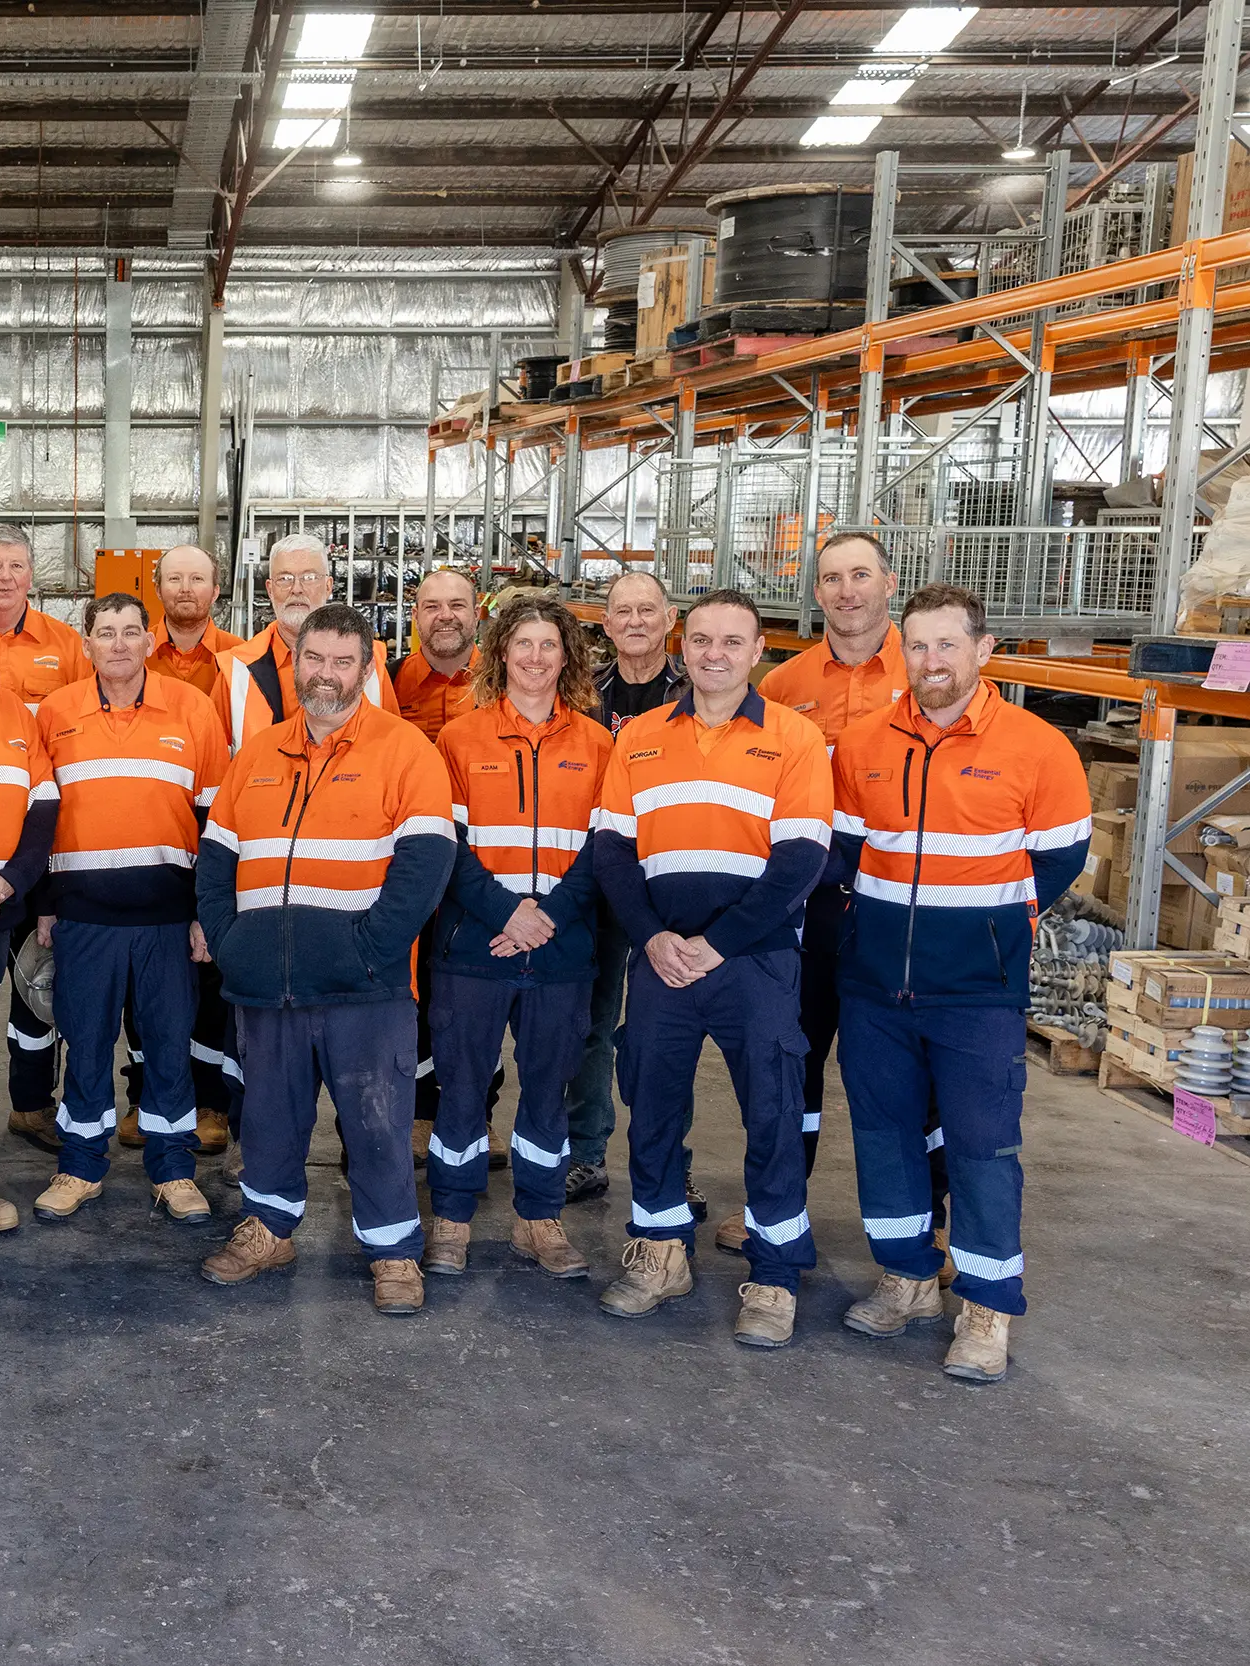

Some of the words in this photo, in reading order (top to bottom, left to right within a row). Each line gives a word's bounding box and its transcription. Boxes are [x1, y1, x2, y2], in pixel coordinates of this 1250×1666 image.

[629, 750, 658, 761] MORGAN
[757, 753, 775, 761] Energy
[759, 749, 782, 758] Essential
[973, 767, 1001, 777] Essential
[973, 772, 994, 781] Energy
